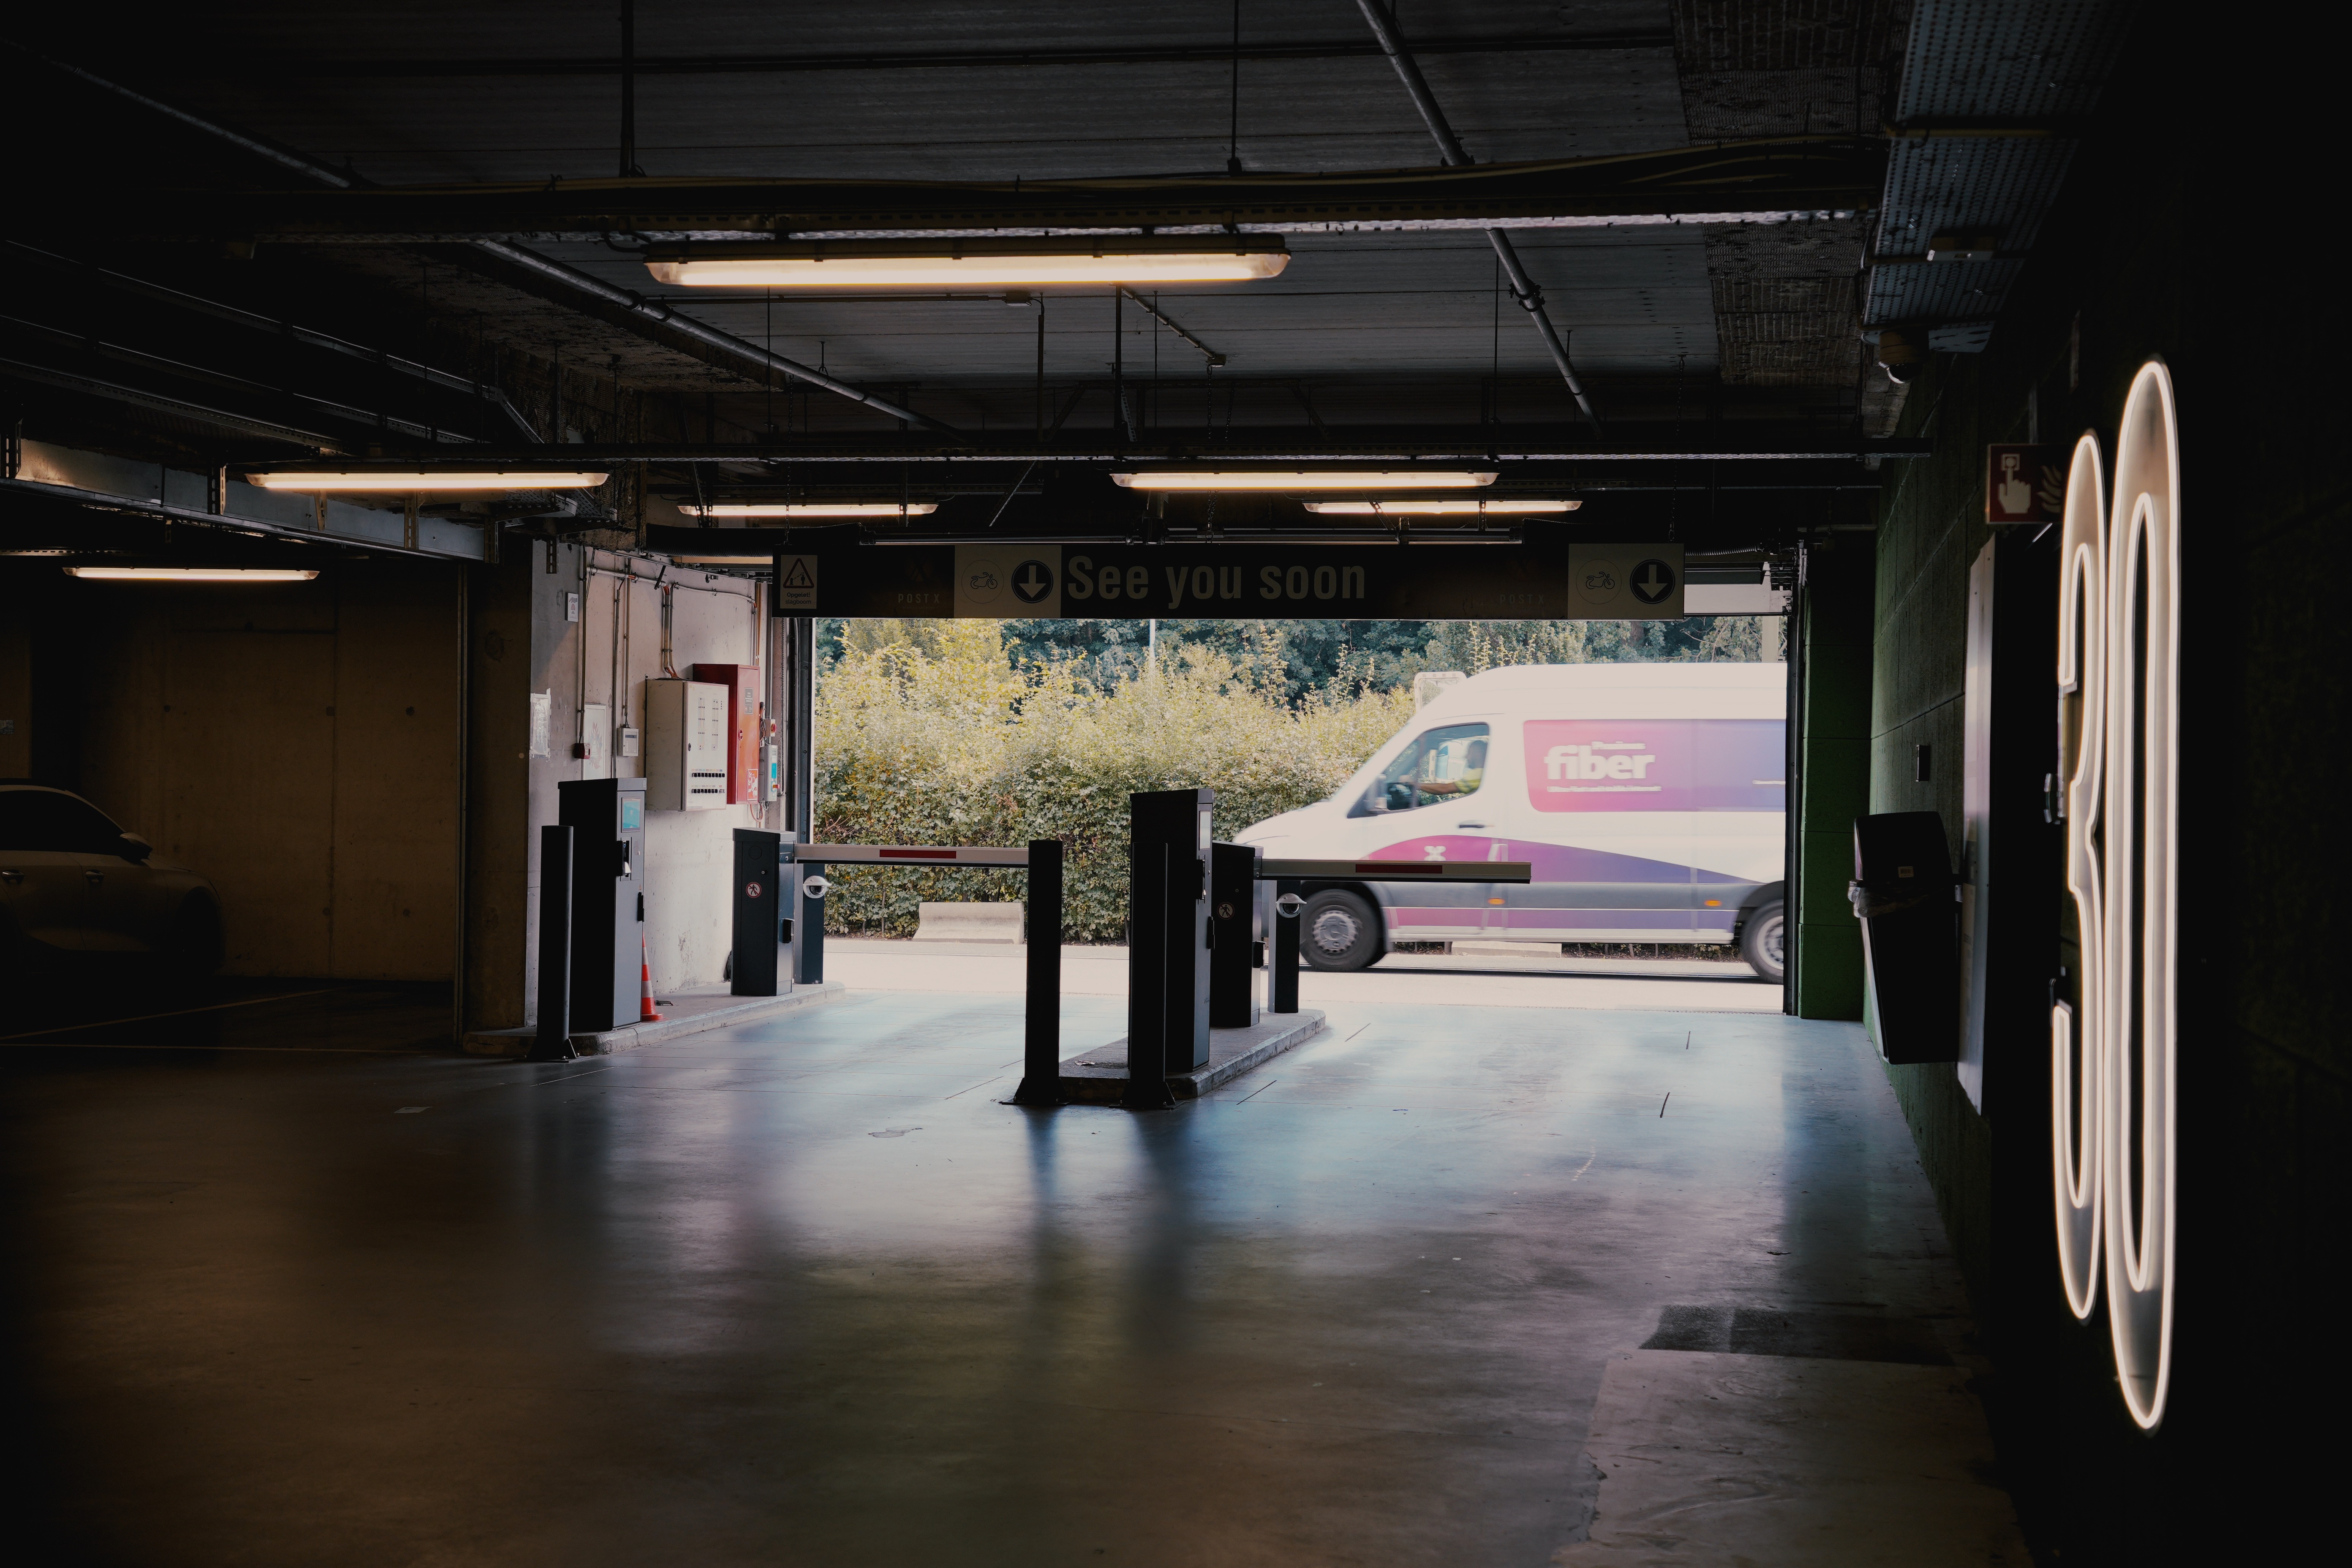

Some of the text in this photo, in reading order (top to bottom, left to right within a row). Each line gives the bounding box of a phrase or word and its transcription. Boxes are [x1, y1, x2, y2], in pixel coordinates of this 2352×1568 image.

[898, 593, 939, 603] POST X
[1068, 555, 1365, 609] See you soon
[1500, 594, 1544, 604] POST X
[1543, 744, 1656, 780] fiber
[2052, 356, 2181, 1434] 30
